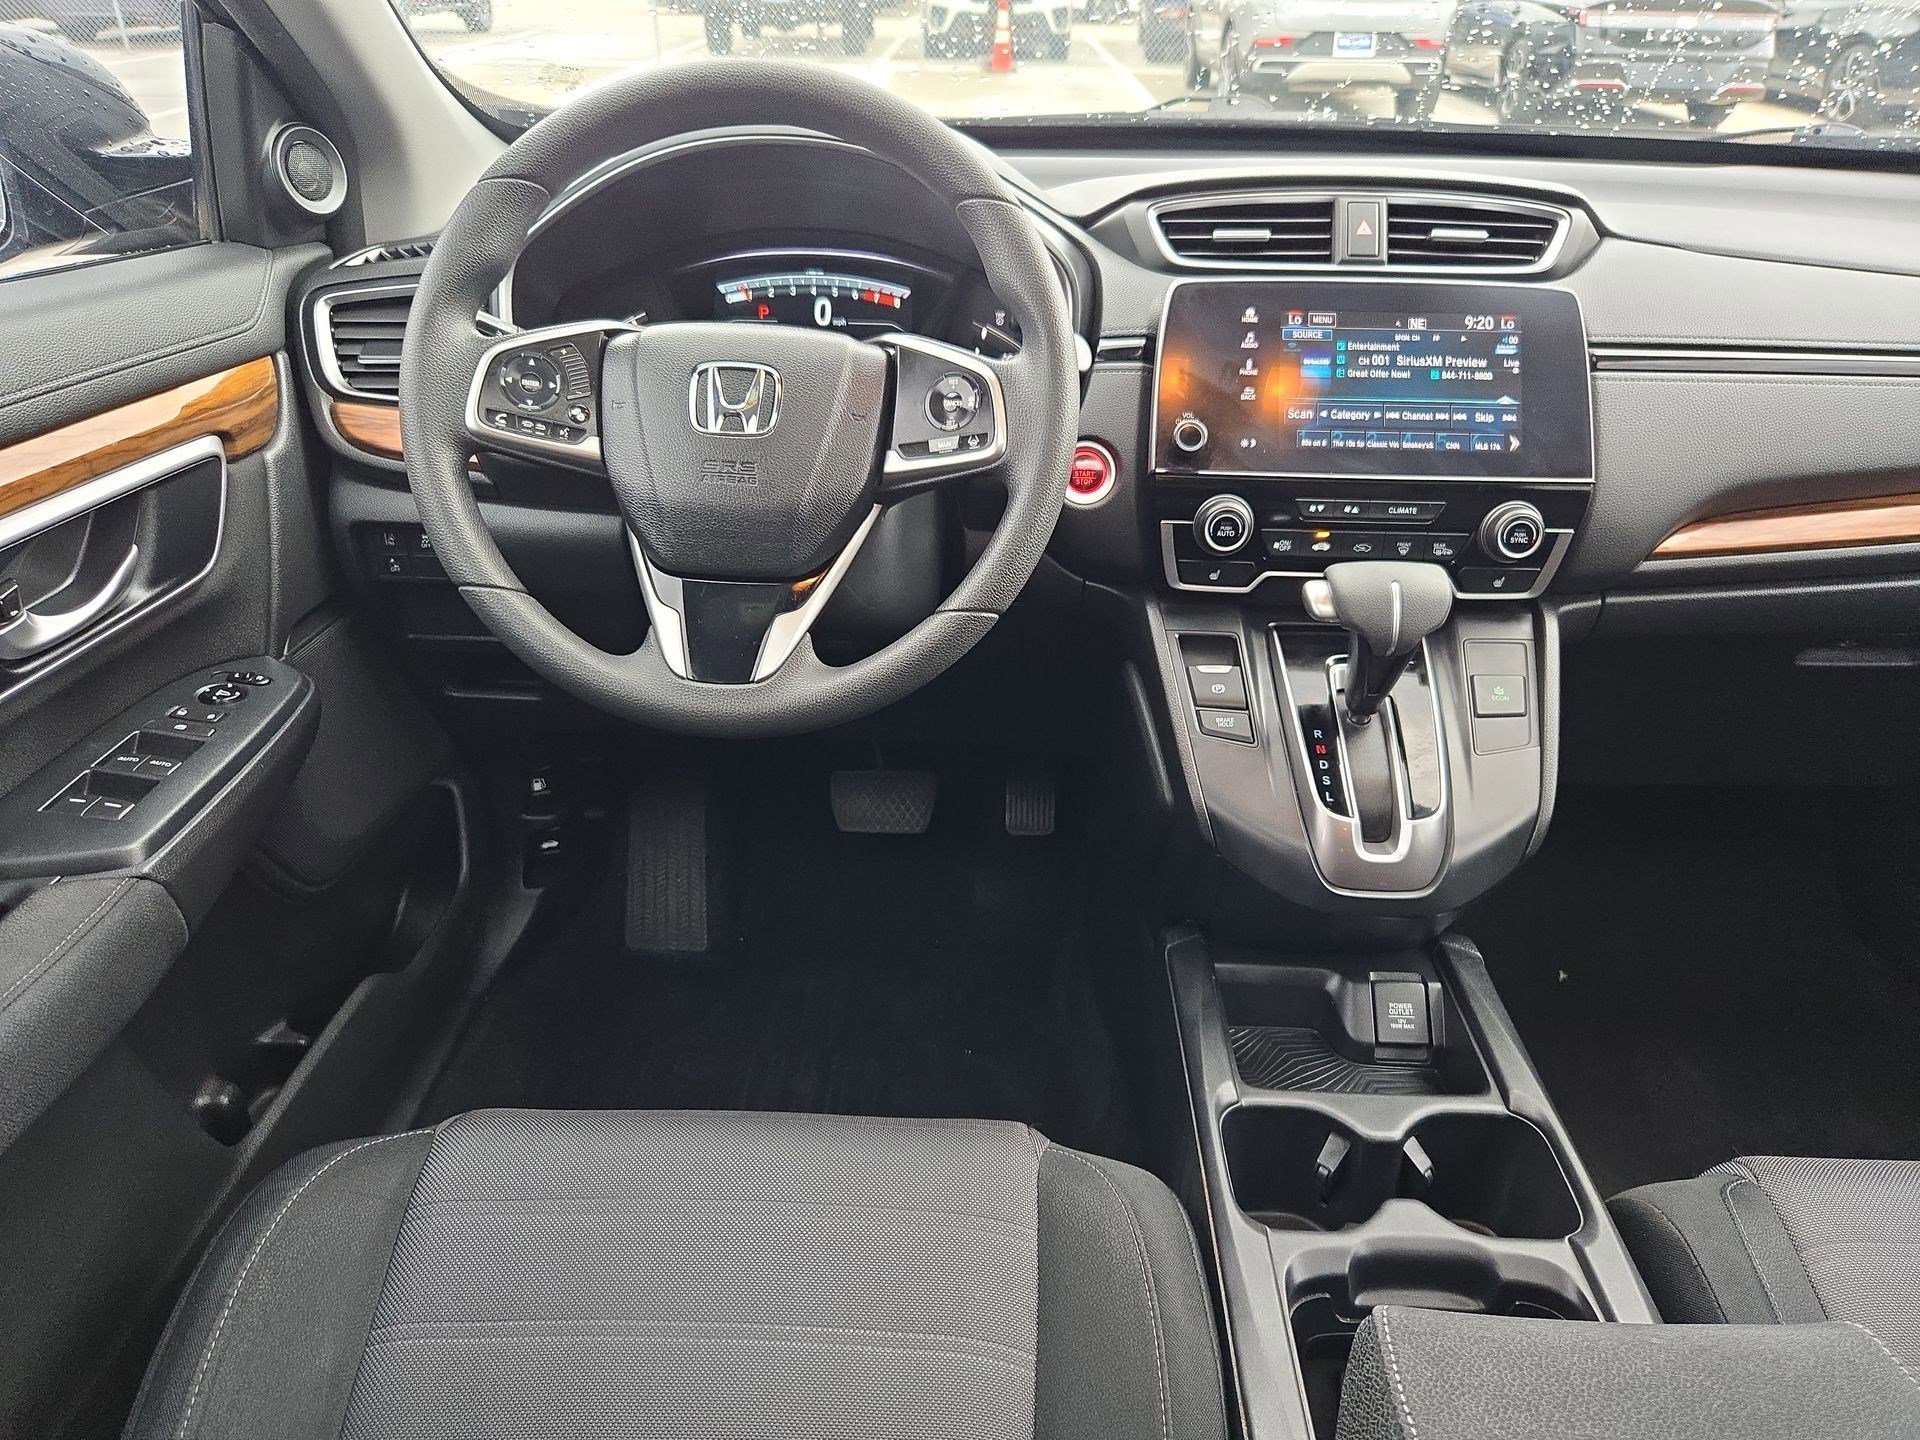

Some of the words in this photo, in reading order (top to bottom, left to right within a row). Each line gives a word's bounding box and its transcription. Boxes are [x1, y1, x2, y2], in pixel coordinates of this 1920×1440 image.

[767, 287, 775, 298] 2
[790, 286, 797, 296] 3
[810, 286, 817, 296] 4
[832, 287, 839, 297] 5
[851, 288, 859, 300] 6
[759, 305, 769, 319] P
[813, 296, 832, 326] 0
[832, 317, 847, 327] mph
[1288, 313, 1302, 325] Lo
[1312, 315, 1333, 324] MENU
[1464, 314, 1494, 330] 9:20
[1501, 318, 1515, 329] Lo
[1292, 331, 1324, 339] SOURCE
[1347, 341, 1401, 352] Entertainment
[1358, 356, 1370, 365] CH
[1371, 354, 1390, 366] 001
[1396, 354, 1443, 367] SiriusXM
[1445, 355, 1488, 368] Preview
[1503, 357, 1520, 368] Live
[1347, 369, 1369, 378] Great
[1369, 369, 1390, 378] Offer
[1390, 369, 1411, 379] Now!
[521, 378, 540, 387] ENTER
[1287, 408, 1313, 420] Scan
[1330, 409, 1372, 421] Category
[1401, 412, 1434, 421] Channel
[1474, 411, 1495, 423] Skip
[1445, 442, 1460, 450] CNN
[701, 460, 757, 473] SRS
[1388, 506, 1418, 515] CLIMATE
[1509, 536, 1529, 544] SYNC
[1313, 729, 1323, 739] R
[1316, 745, 1326, 754] N
[117, 755, 140, 763] AUTO
[149, 759, 173, 768] AUTO
[1319, 760, 1328, 769] D
[1322, 776, 1331, 785] S
[1325, 791, 1335, 802] L
